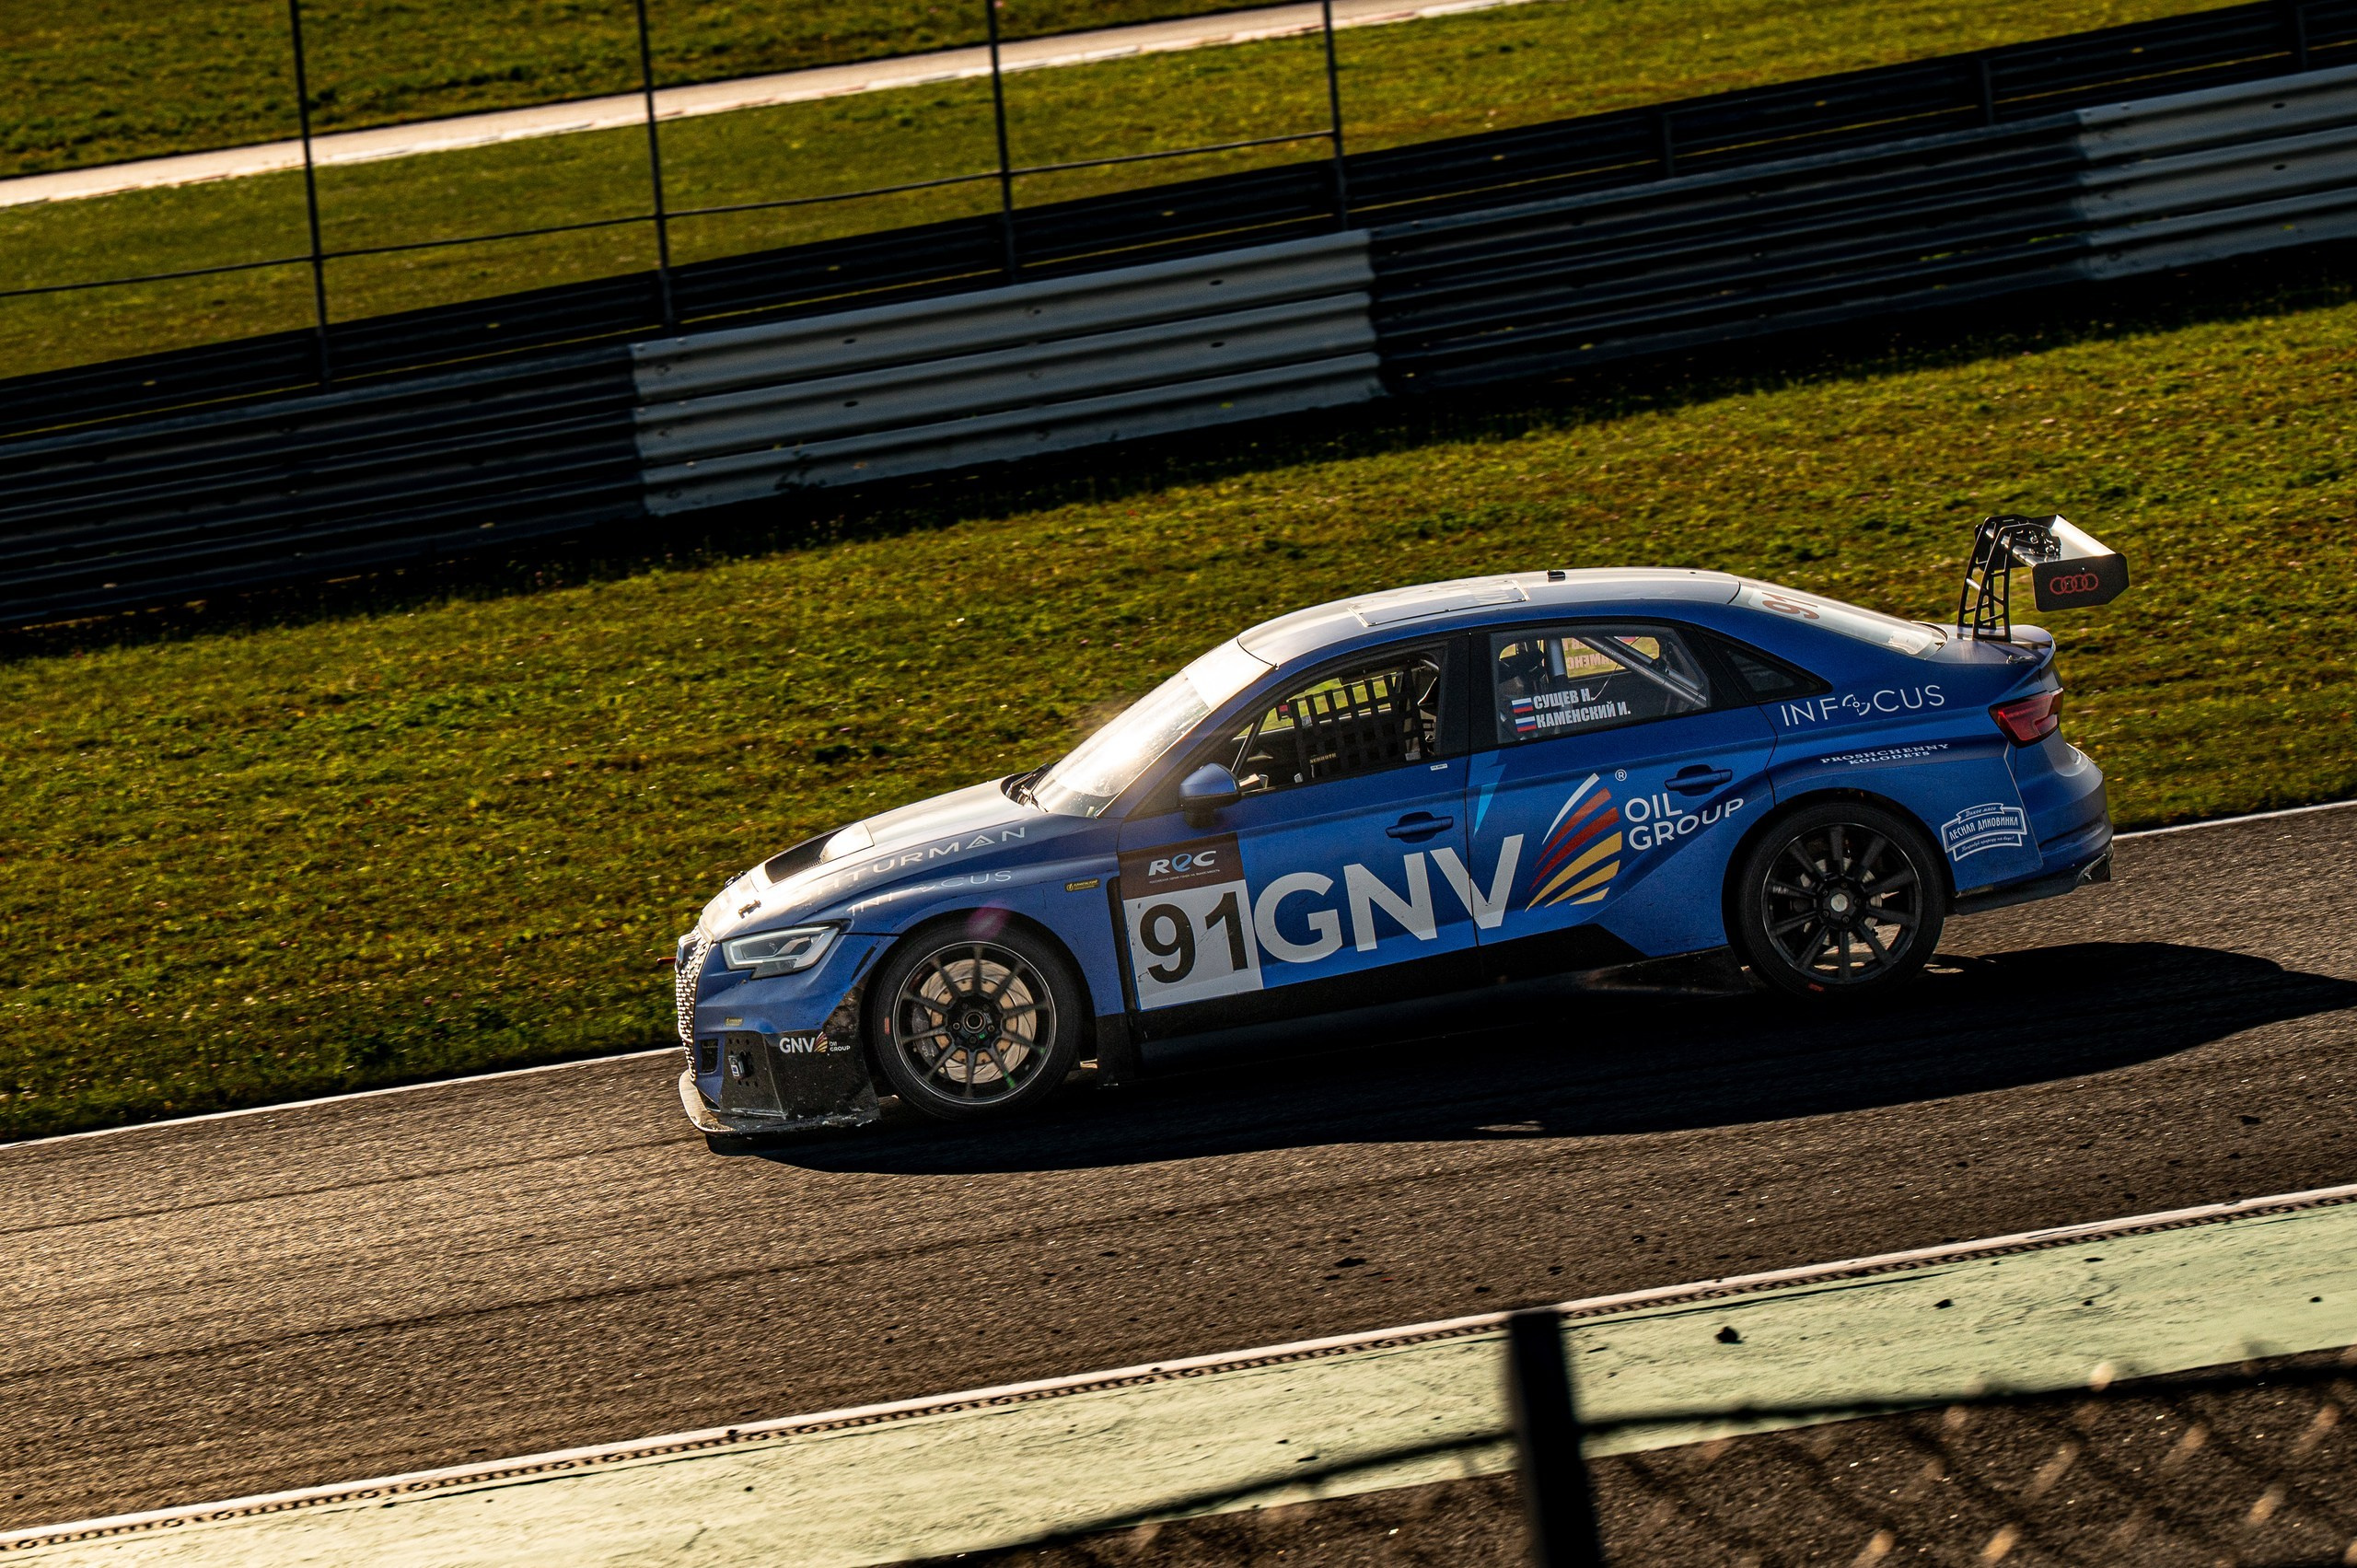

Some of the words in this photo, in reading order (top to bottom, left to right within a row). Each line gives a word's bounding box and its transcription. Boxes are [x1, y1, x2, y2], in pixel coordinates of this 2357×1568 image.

[1532, 688, 1580, 710] СУЩЕВ
[1535, 700, 1618, 728] КАМЕНСКИЙ
[1617, 701, 1631, 715] И.
[1820, 743, 1949, 763] PROSHCHENNY
[1848, 750, 1931, 765] KOLODETS
[1624, 793, 1683, 823] OIL
[1629, 797, 1744, 851] GROUP
[1949, 822, 1976, 841] ЛЕСНАЯ
[1978, 816, 2019, 831] ДИКОВИНКА
[1253, 833, 1525, 964] GNV
[1139, 891, 1249, 984] 91
[779, 1037, 815, 1053] GNV
